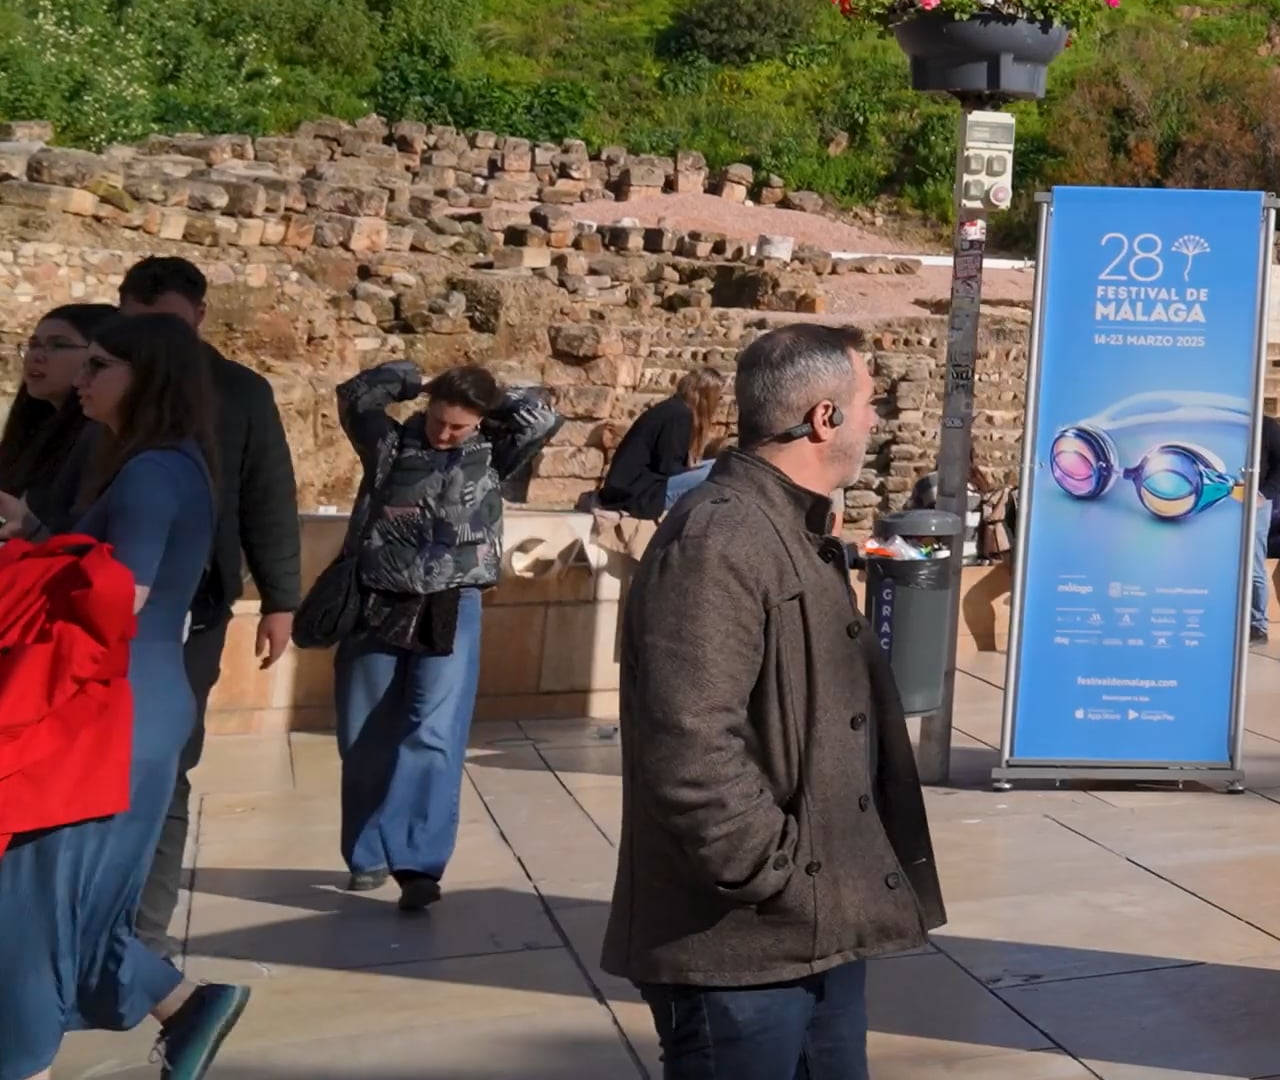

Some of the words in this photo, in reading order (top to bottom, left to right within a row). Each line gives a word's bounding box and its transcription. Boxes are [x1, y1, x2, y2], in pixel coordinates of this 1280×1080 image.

[1098, 232, 1164, 282] 28
[1096, 286, 1180, 303] FESTIVAL
[1186, 288, 1209, 302] DE
[1094, 300, 1207, 324] MÁLAGA
[1094, 334, 1124, 346] 14-23
[1126, 335, 1174, 347] MARZO
[1175, 336, 1206, 348] 2025
